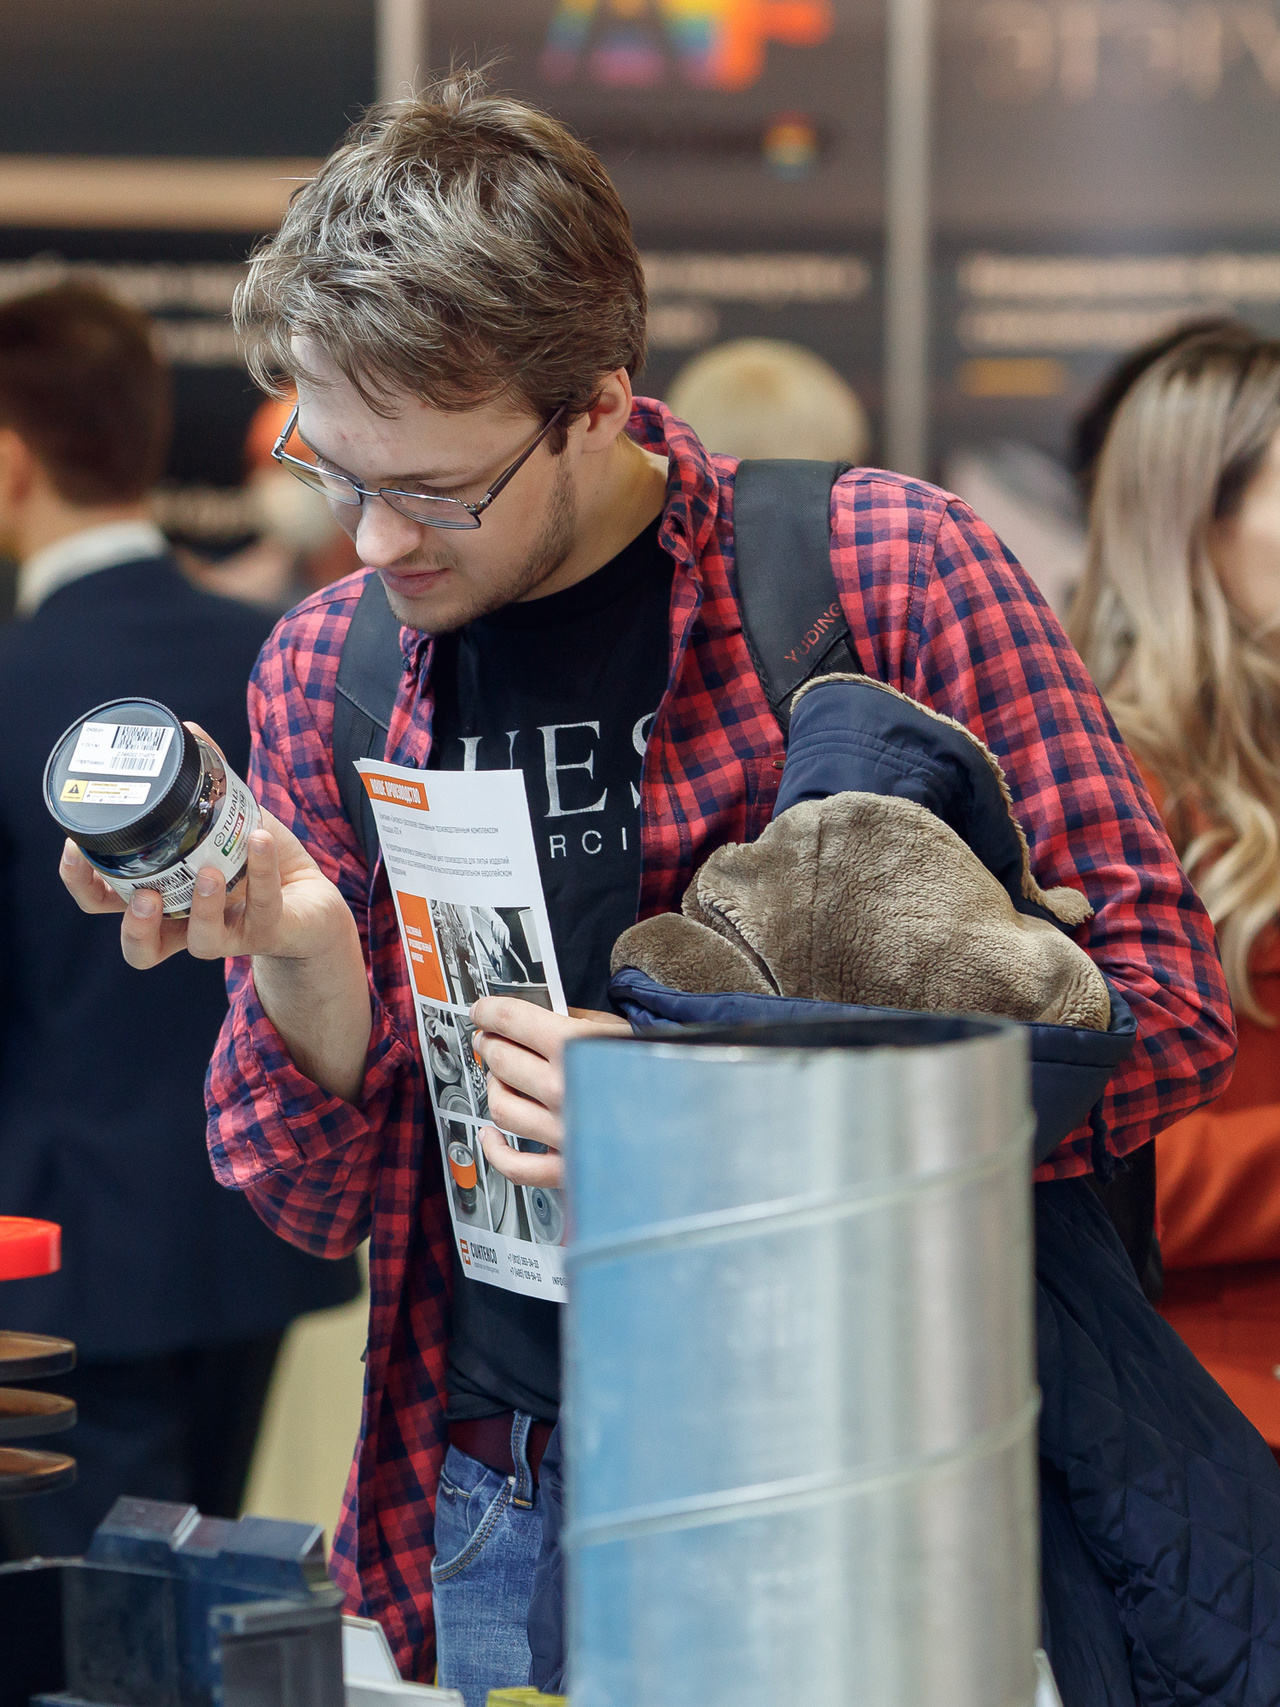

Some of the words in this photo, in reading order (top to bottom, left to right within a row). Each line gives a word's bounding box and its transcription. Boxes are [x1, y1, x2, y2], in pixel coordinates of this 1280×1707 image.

[784, 602, 842, 664] YUDING
[223, 788, 239, 832] TUBALL
[224, 818, 244, 853] MATRIX
[549, 827, 627, 859] RCI
[552, 1276, 568, 1287] INFO@
